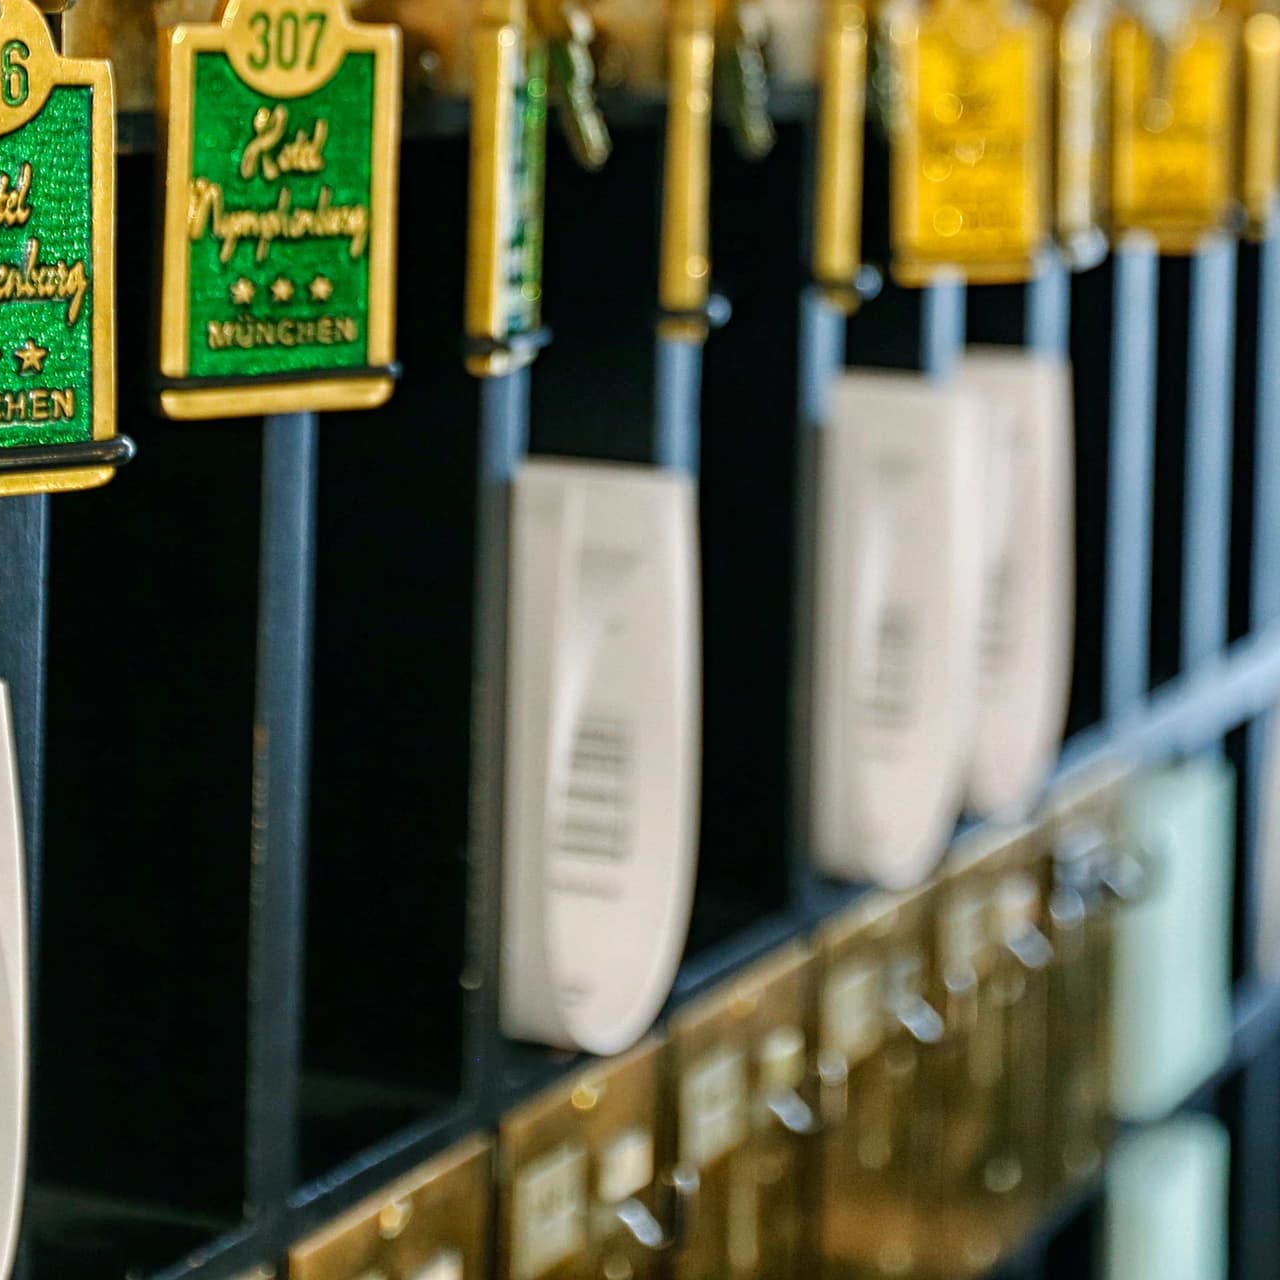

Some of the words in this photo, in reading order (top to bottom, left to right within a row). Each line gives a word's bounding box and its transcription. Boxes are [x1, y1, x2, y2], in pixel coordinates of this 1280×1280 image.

[247, 11, 327, 71] 307
[241, 104, 328, 180] Hotel
[187, 176, 368, 264] Nymphenburg
[208, 314, 357, 350] MÜNCHEN
